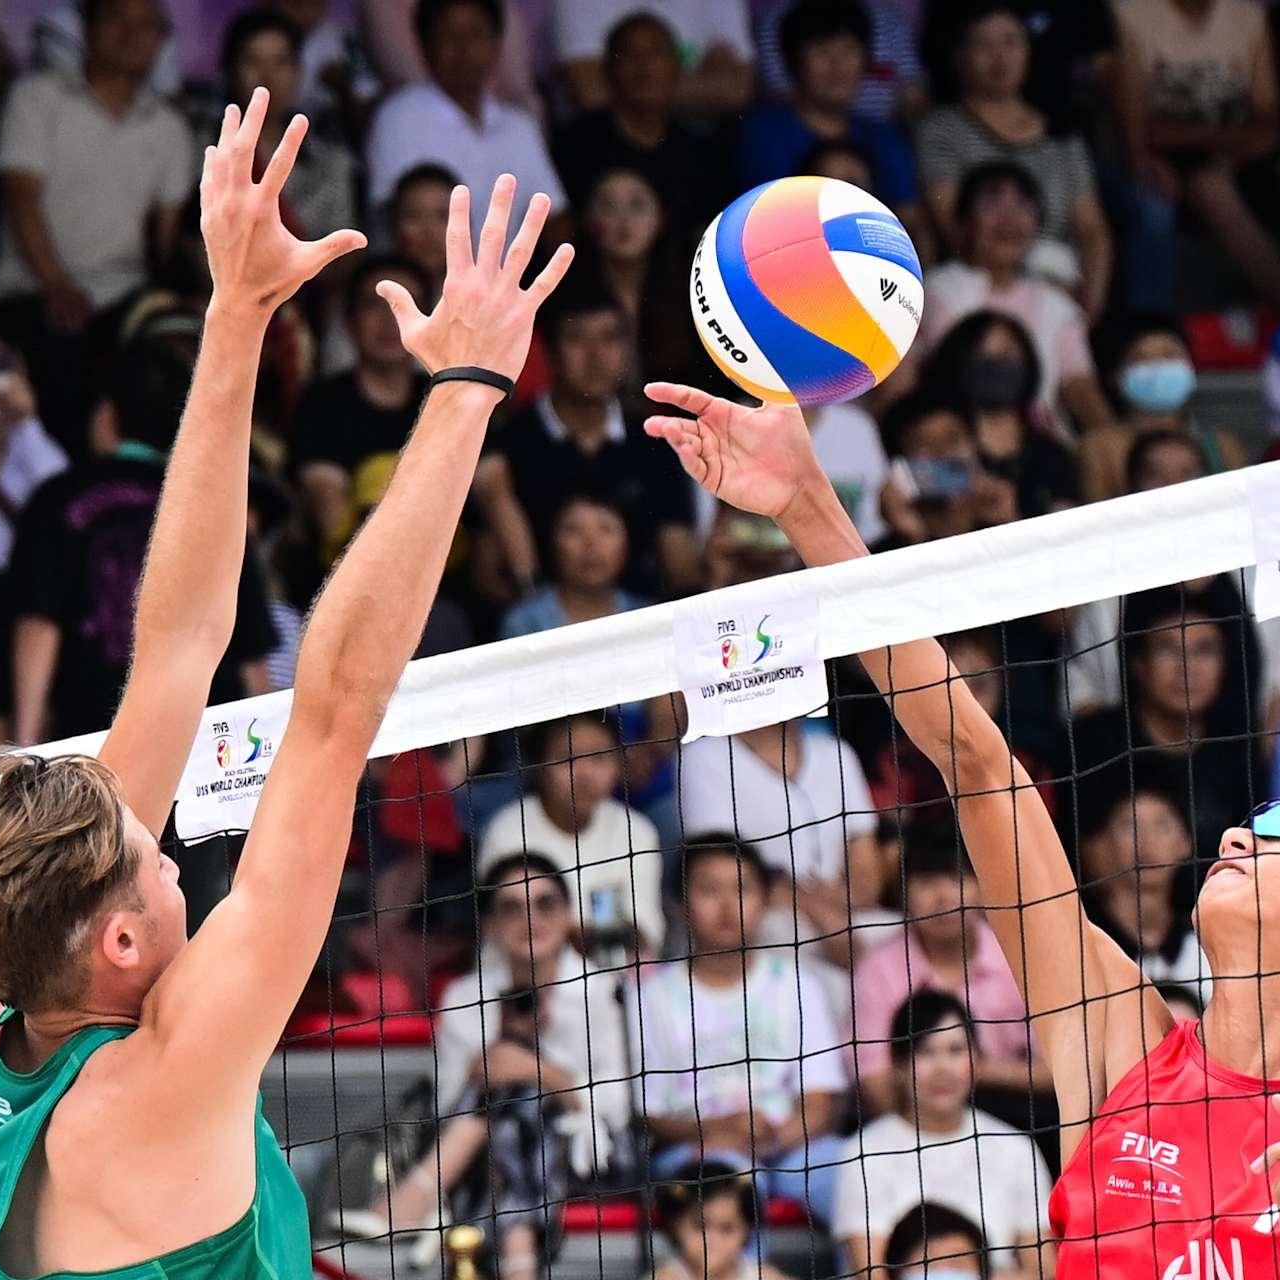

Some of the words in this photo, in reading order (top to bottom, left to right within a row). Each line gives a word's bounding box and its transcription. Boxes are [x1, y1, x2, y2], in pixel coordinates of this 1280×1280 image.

[707, 319, 749, 364] PRO
[717, 619, 737, 635] FIVB
[716, 678, 742, 696] WORLD
[743, 665, 805, 689] CHAMPIONSHIPS
[212, 721, 230, 735] FIVB
[210, 779, 233, 794] WORLD
[1121, 1131, 1180, 1166] FIVB
